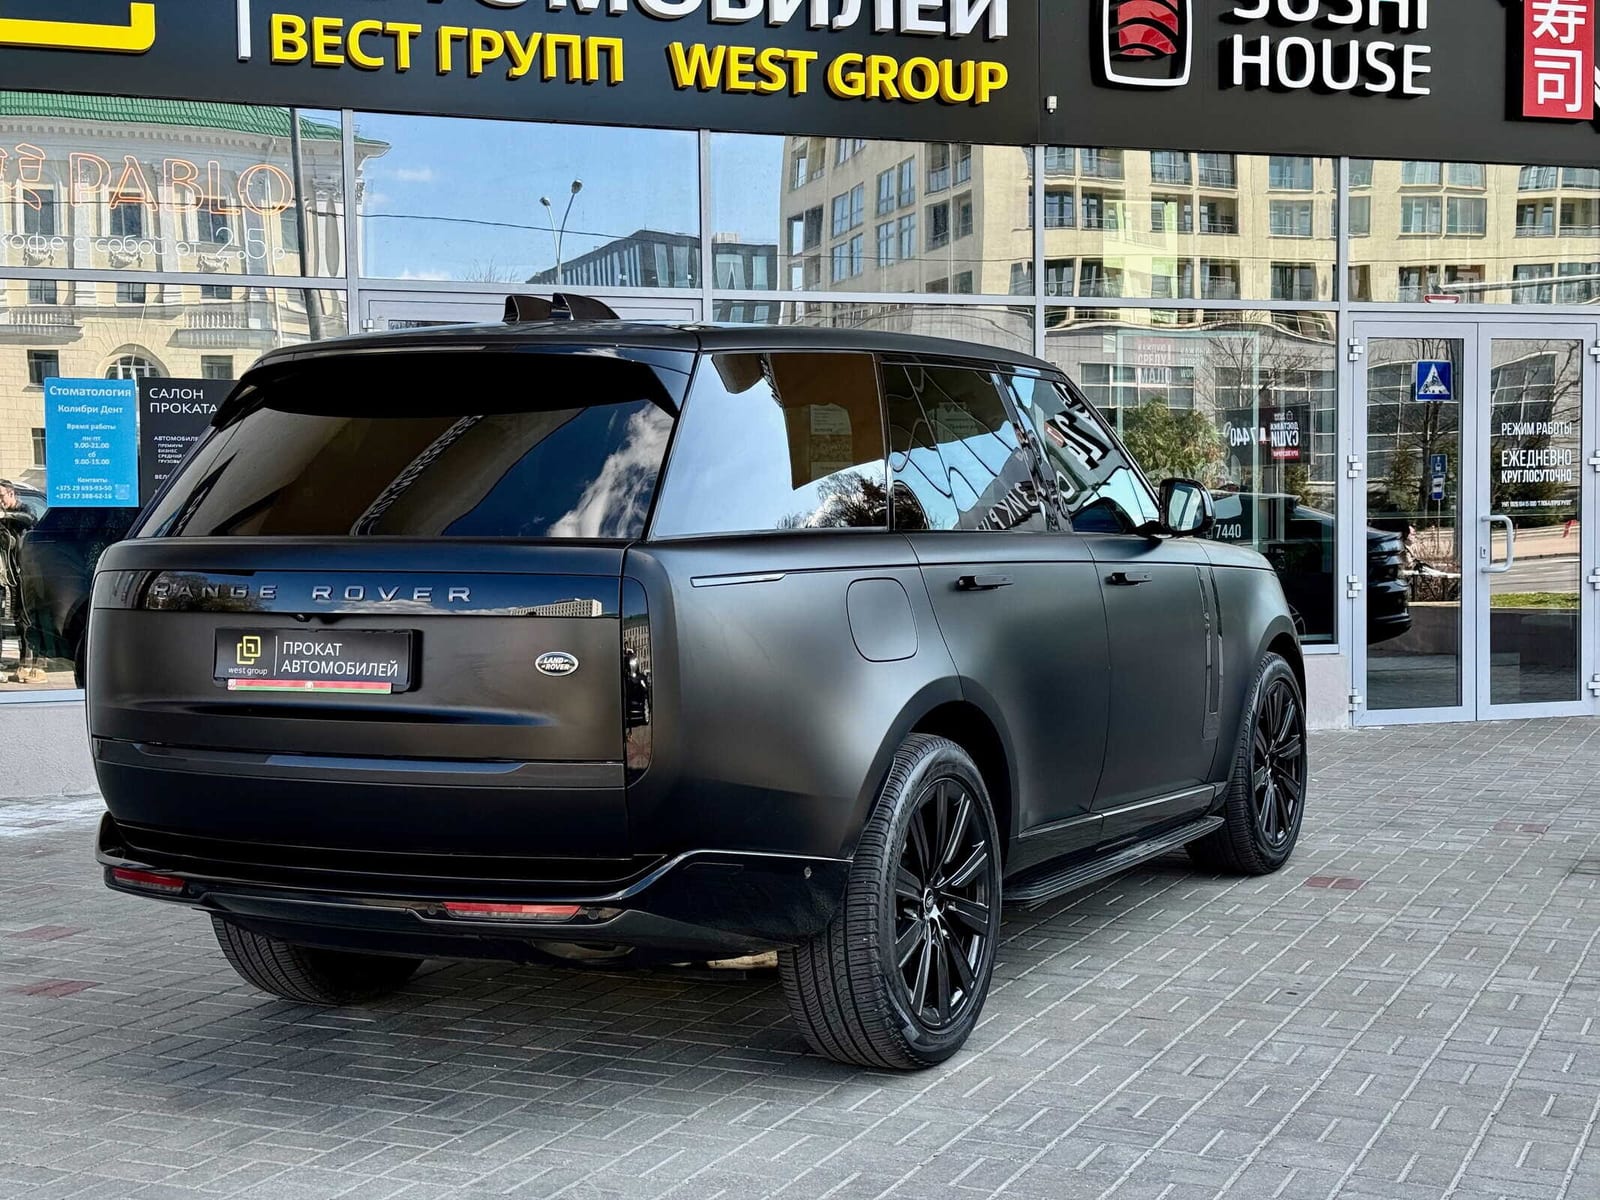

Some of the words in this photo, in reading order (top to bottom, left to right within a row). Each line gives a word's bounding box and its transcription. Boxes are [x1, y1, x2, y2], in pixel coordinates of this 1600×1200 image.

[270, 13, 421, 72] ВЕСТ
[437, 26, 625, 85] ГРУПП
[1233, 34, 1431, 95] HOUSE
[669, 41, 818, 95] WEST
[828, 52, 1009, 104] GROUP
[69, 152, 294, 217] PABLO
[95, 235, 168, 255] собой
[175, 240, 201, 257] от
[49, 385, 132, 398] Стоматология
[149, 387, 204, 400] САЛОН
[57, 404, 99, 415] Колибри
[100, 405, 124, 415] Дент
[150, 402, 218, 414] ПРОКАТА
[66, 423, 89, 431] Время
[1501, 422, 1535, 436] РЕЖИМ
[1536, 422, 1572, 435] РАБОТЫ
[1501, 449, 1572, 468] ЕЖЕДНЕВНО
[1501, 469, 1572, 483] КРУГЛОСУТОЧНО
[1215, 524, 1242, 538] 7440
[152, 584, 278, 600] RANGE
[311, 585, 472, 603] ROVER
[282, 641, 343, 657] ПРОКАТ
[543, 656, 564, 664] LAND
[545, 663, 570, 671] ROVER
[247, 668, 268, 677] group
[280, 659, 399, 678] АВТОМОБИЛЕЙ
